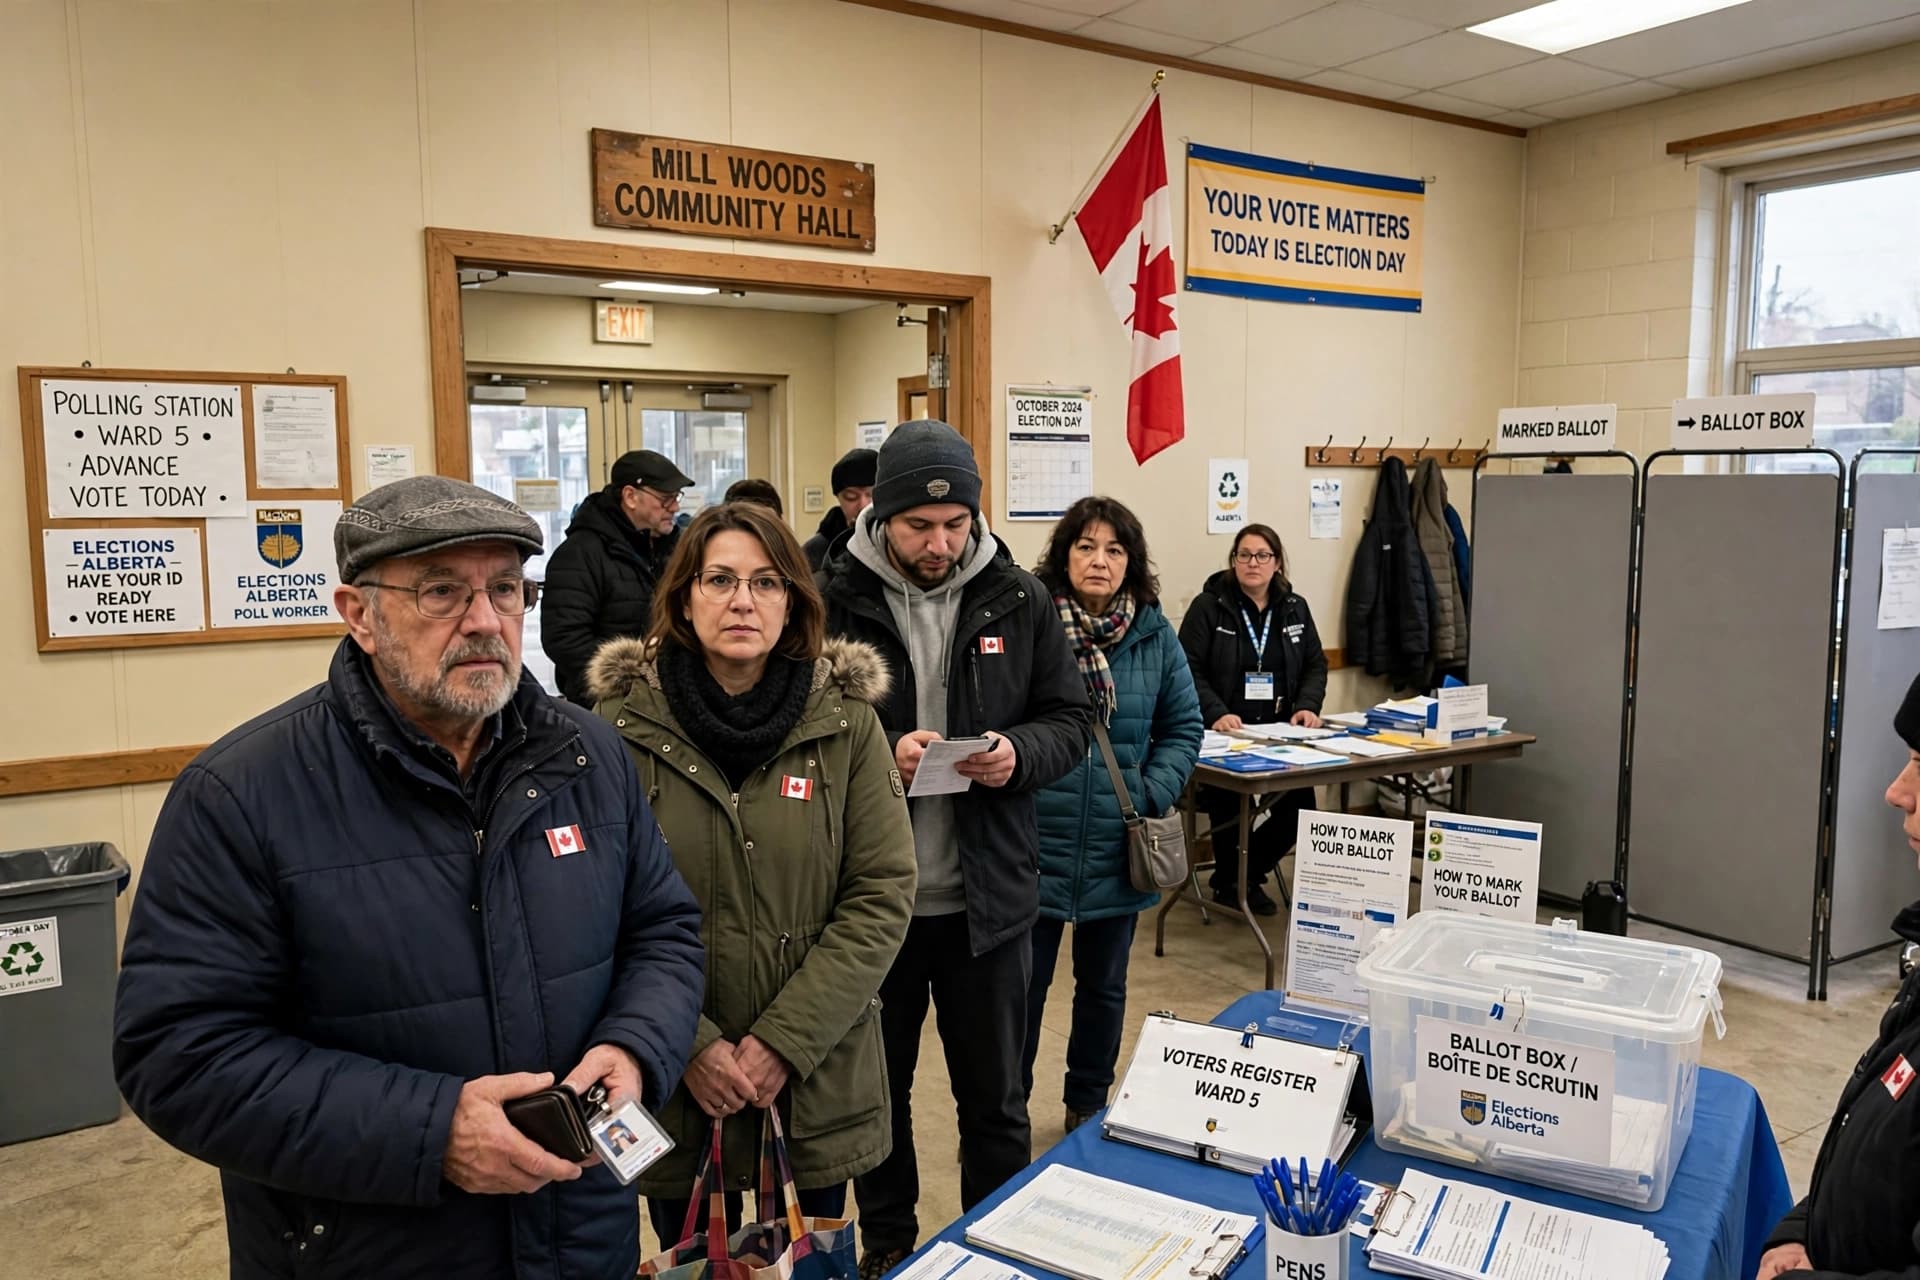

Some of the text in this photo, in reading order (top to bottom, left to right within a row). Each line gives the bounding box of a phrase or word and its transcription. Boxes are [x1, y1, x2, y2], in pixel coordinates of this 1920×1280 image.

[652, 147, 826, 198] MILL WOODS
[615, 183, 861, 239] COMMUNITY HALL
[1204, 187, 1410, 240] YOUR VOTE MATTERS
[1211, 229, 1405, 273] TODAY IS ELECTION DAY
[608, 306, 645, 337] EXIT
[54, 391, 233, 417] POLLING STATION
[1016, 400, 1082, 412] OCTOBER 2024
[1018, 415, 1082, 427] ELECTION DAY
[1502, 420, 1608, 438] MARKED BALLOT
[1701, 410, 1805, 431] BALLOT BOX
[98, 425, 189, 446] WARD 5
[80, 455, 179, 476] ADVANCE
[70, 486, 207, 507] VOTE TODAY
[73, 540, 174, 554] ELECTIONS
[82, 557, 165, 570] ALBERTA
[67, 572, 182, 588] HAVE YOUR ID
[238, 574, 326, 588] ELECTIONS
[97, 591, 151, 605] READY
[246, 588, 317, 602] ALBERTA
[86, 608, 175, 623] VOTE HERE
[235, 605, 328, 619] POLL WORKER
[1310, 823, 1395, 845] HOW TO MARK
[1312, 840, 1393, 861] YOUR BALLOT
[1434, 869, 1522, 892] HOW TO MARK
[1434, 885, 1520, 908] YOUR BALLOT
[34, 923, 49, 931] DAY
[1450, 1033, 1577, 1073] BALLOT BOX /
[1163, 1047, 1316, 1092] VOTERS REGISTER
[1428, 1052, 1599, 1102] BOÎTE DE SCRUTIN
[1195, 1080, 1260, 1108] WARD 5
[1492, 1100, 1559, 1125] Elections
[1491, 1114, 1545, 1137] Alberta
[1276, 1255, 1325, 1280] PENS
